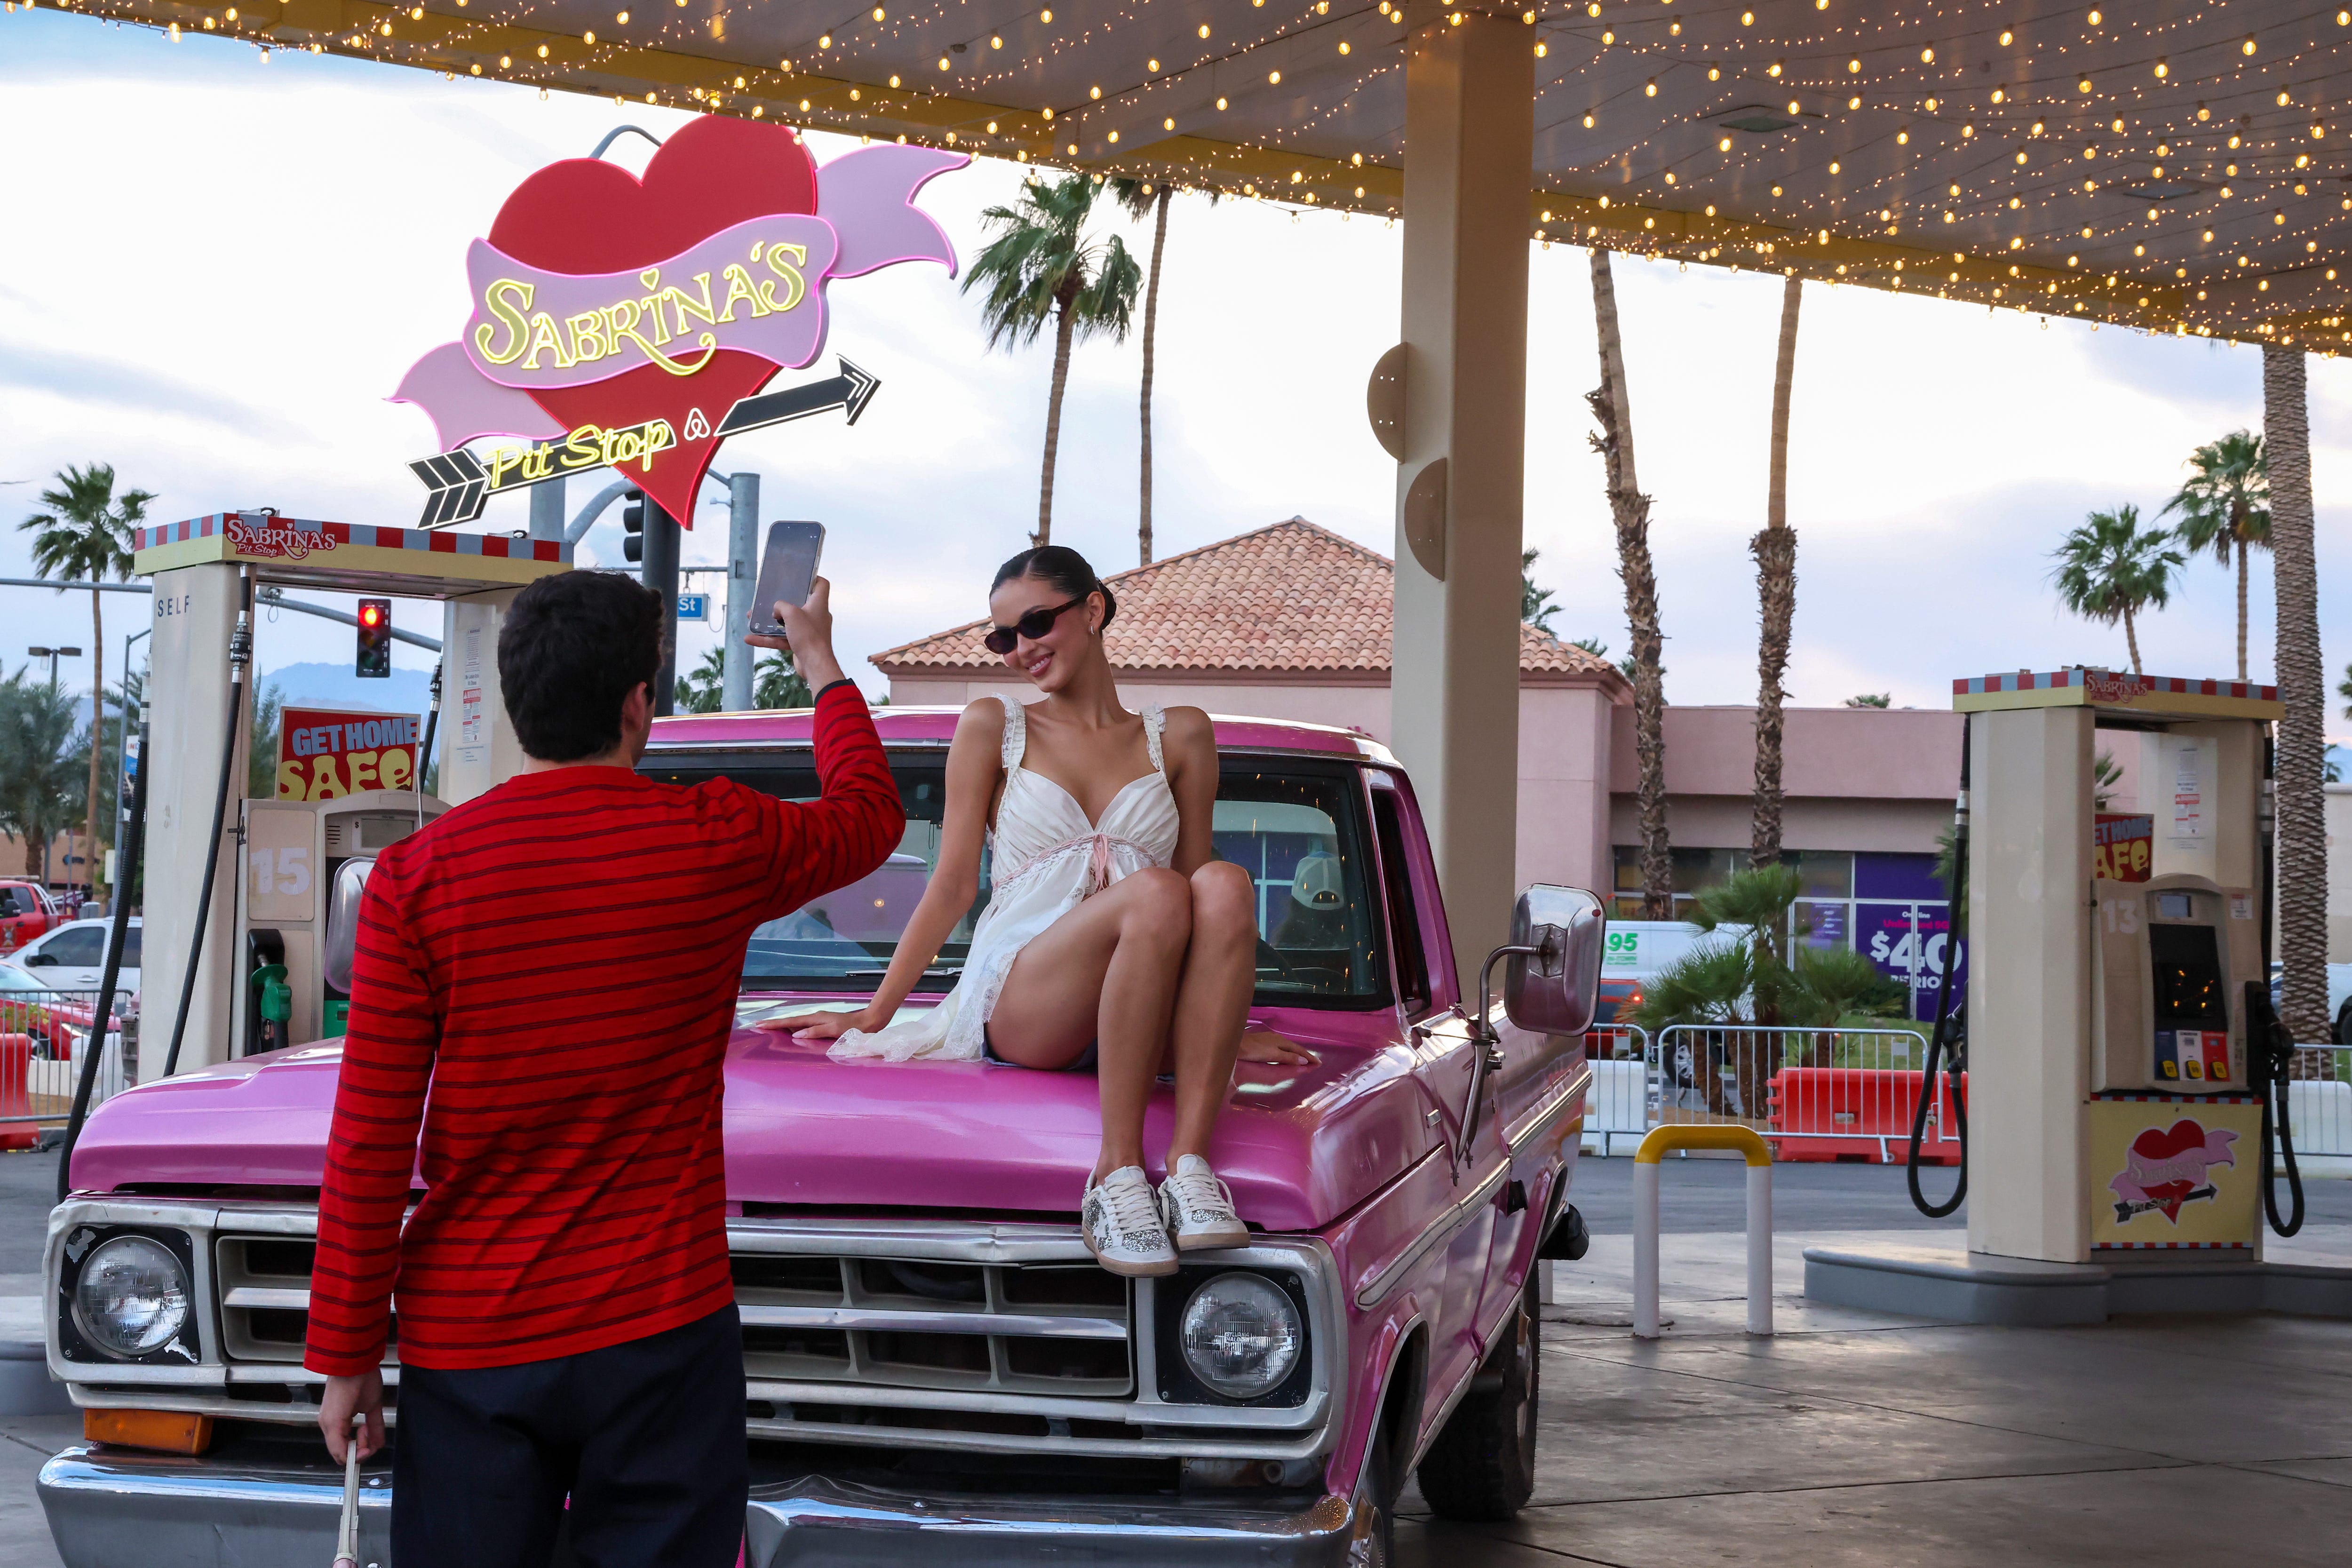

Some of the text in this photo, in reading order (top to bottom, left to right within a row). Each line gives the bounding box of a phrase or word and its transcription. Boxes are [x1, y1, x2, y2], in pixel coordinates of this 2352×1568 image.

[475, 240, 807, 375] SABRINA'S
[484, 422, 669, 487] Pit Stop
[227, 519, 335, 559] SABRINA'S
[237, 543, 277, 557] Pit Stop
[158, 595, 189, 617] SELF
[679, 598, 695, 611] St
[292, 717, 417, 756] GET HOME
[2095, 823, 2109, 845] ET
[2111, 817, 2152, 842] HOME
[251, 848, 310, 894] 15
[2095, 840, 2149, 879] AFe
[2103, 899, 2139, 933] 13
[1870, 930, 1963, 975] $40
